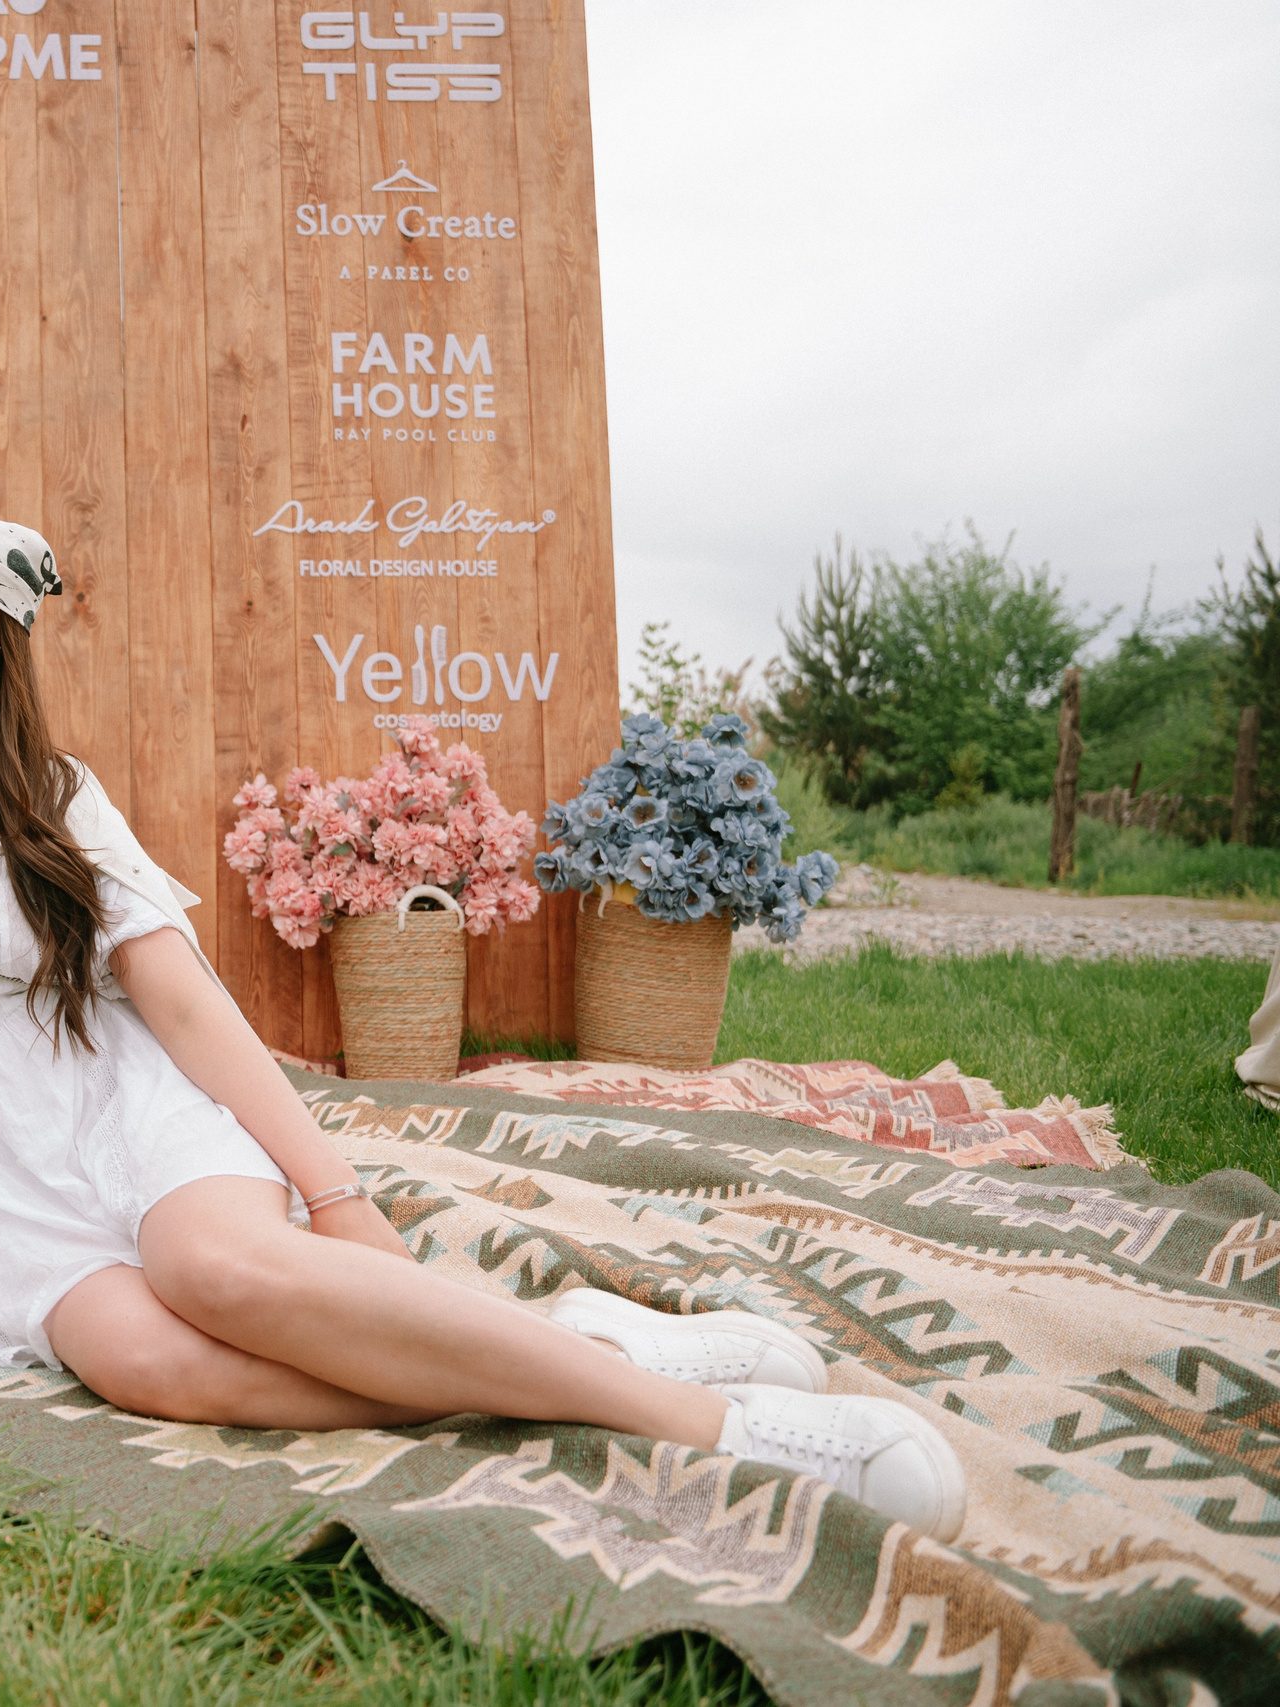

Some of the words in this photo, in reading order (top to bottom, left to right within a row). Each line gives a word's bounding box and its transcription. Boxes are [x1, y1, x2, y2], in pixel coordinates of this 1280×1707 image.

[300, 11, 505, 50] GLYP
[302, 62, 502, 102] TISS
[296, 203, 386, 237] Slow
[396, 205, 516, 240] Create
[331, 332, 494, 375] FARM
[332, 382, 497, 419] HOUSE
[333, 428, 371, 441] RAY
[383, 428, 436, 442] POOL
[447, 429, 497, 443] CLUB
[299, 560, 366, 577] FLORAL
[370, 560, 434, 577] DESIGN
[437, 560, 498, 577] HOUSE
[313, 624, 559, 706] Yellow
[373, 708, 503, 733] cosetology
